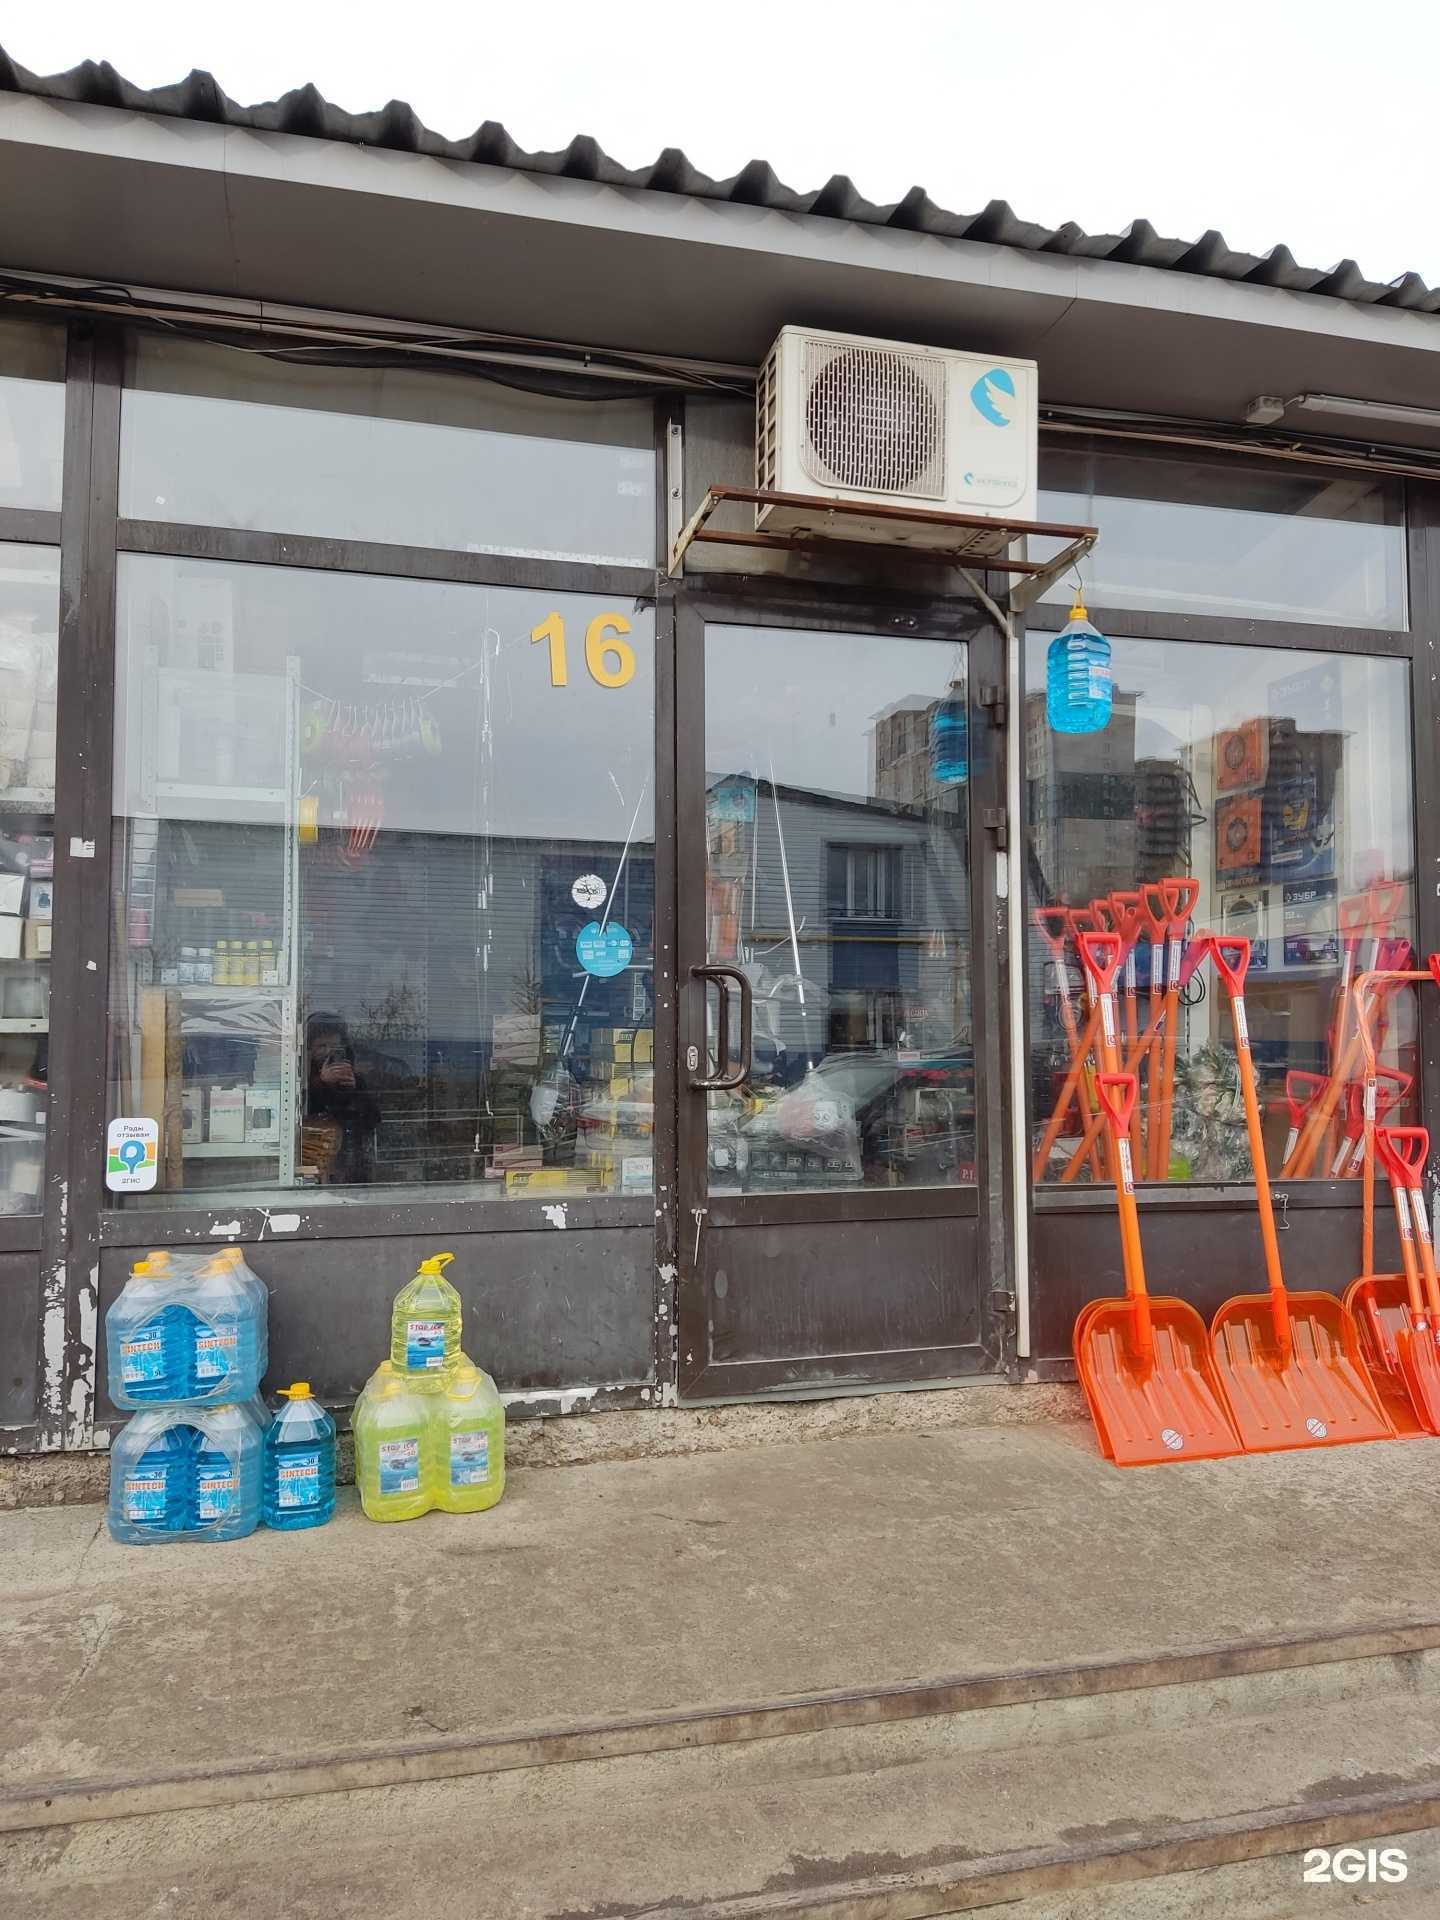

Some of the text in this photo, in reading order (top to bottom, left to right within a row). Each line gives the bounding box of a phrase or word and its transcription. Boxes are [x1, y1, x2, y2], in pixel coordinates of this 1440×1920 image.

[529, 611, 637, 689] 16
[1292, 890, 1317, 901] ЗУБР
[280, 1467, 317, 1478] SINTECH
[127, 1481, 164, 1491] SINTECH
